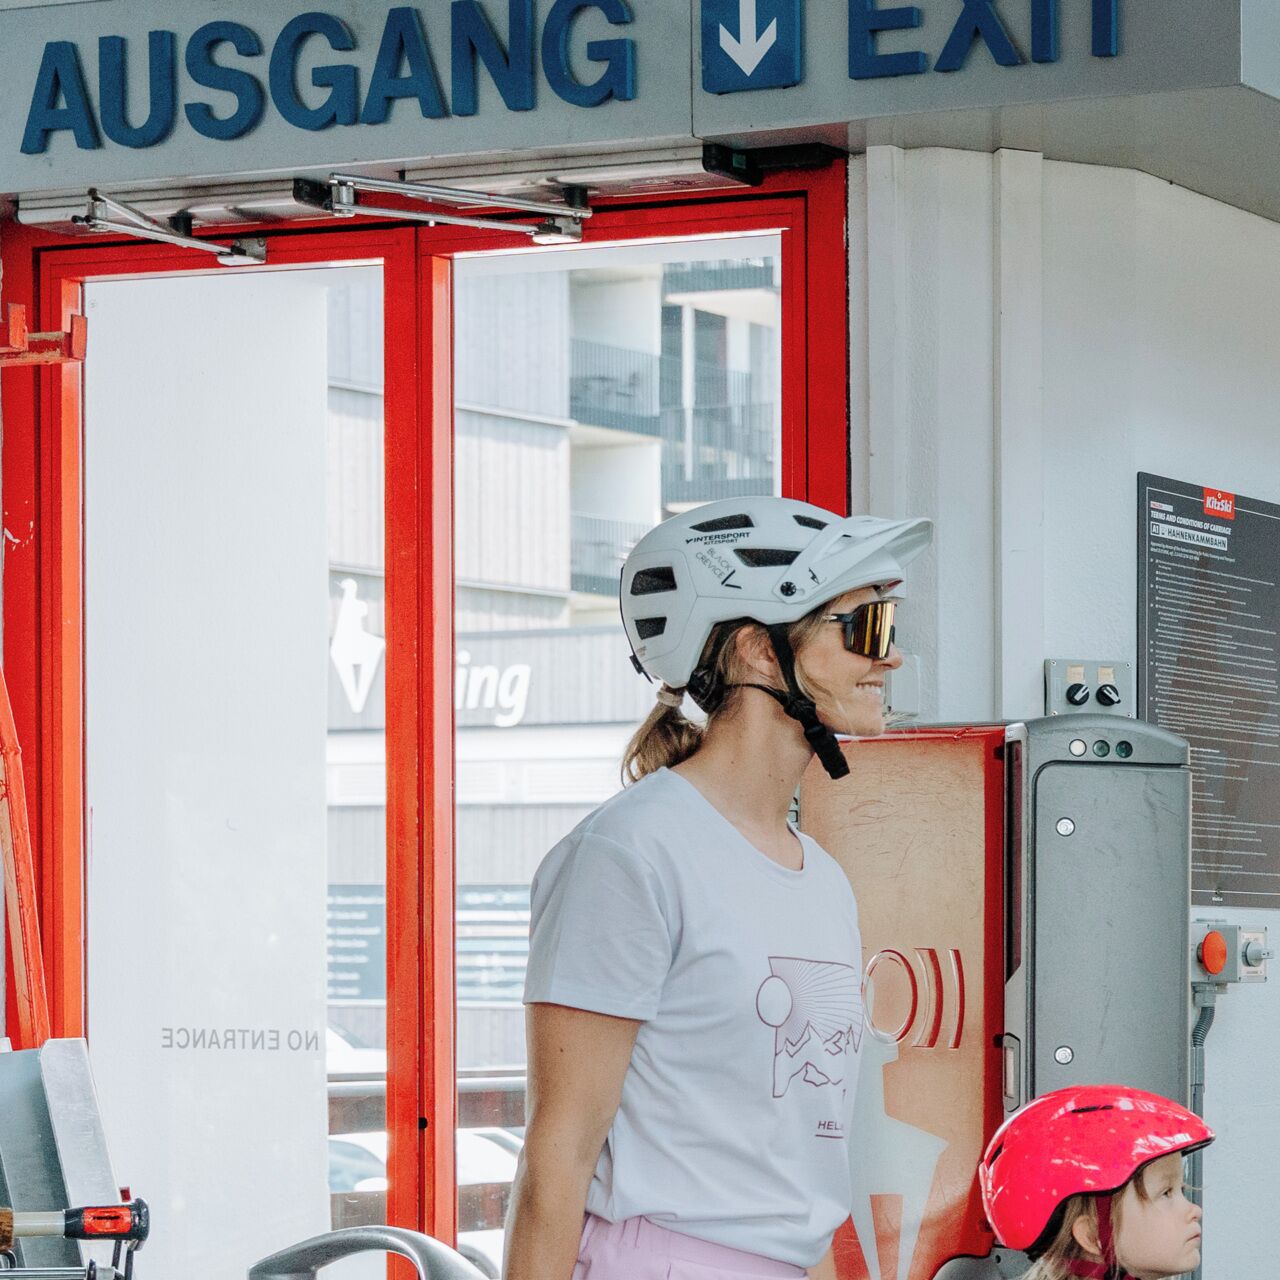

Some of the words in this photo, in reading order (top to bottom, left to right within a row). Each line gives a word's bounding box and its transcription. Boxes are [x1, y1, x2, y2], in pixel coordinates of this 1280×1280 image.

[20, 0, 636, 154] AUSGANG
[1205, 496, 1232, 513] KitzSki
[693, 532, 751, 543] INTERSPORT
[1167, 527, 1227, 549] HAHNENKAMMBAHN
[455, 648, 532, 728] ing
